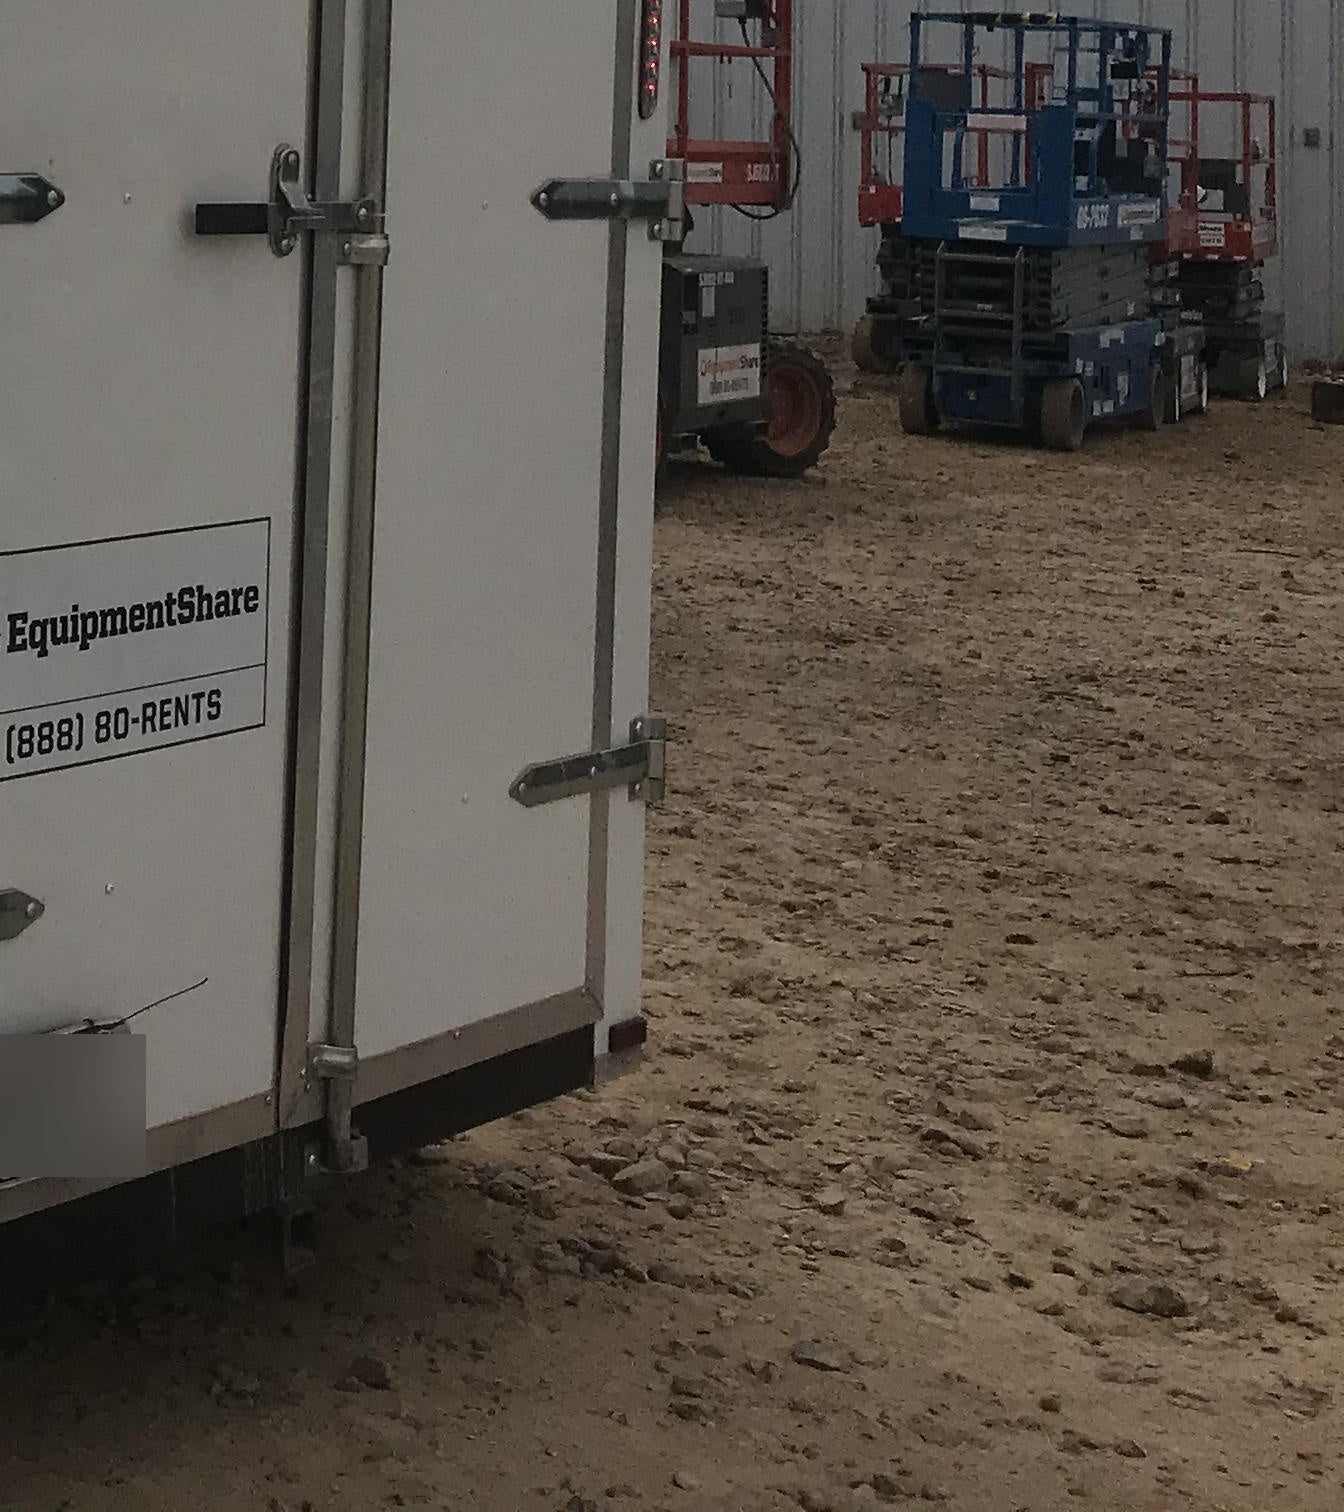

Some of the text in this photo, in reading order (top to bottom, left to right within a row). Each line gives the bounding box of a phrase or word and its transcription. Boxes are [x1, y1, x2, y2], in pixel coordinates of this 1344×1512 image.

[5, 582, 260, 658] EquipmentShare
[5, 688, 222, 764] (888) 80-RENTS
